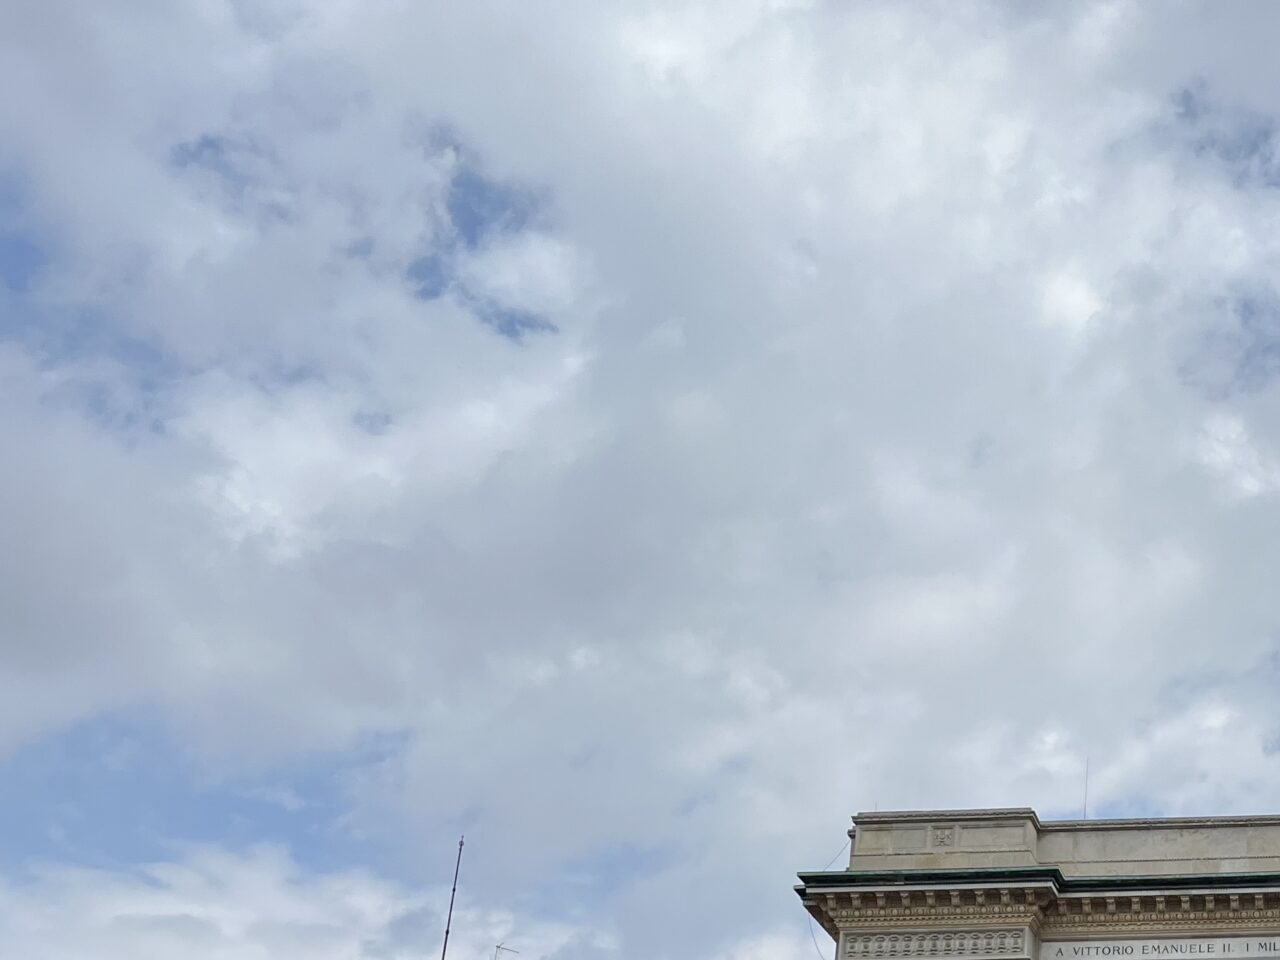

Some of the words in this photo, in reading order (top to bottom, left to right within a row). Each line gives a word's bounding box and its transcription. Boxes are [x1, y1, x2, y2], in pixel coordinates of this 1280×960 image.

[1056, 947, 1064, 956] A
[1073, 945, 1134, 956] VITTORIO
[1141, 943, 1215, 955] EMANUELE
